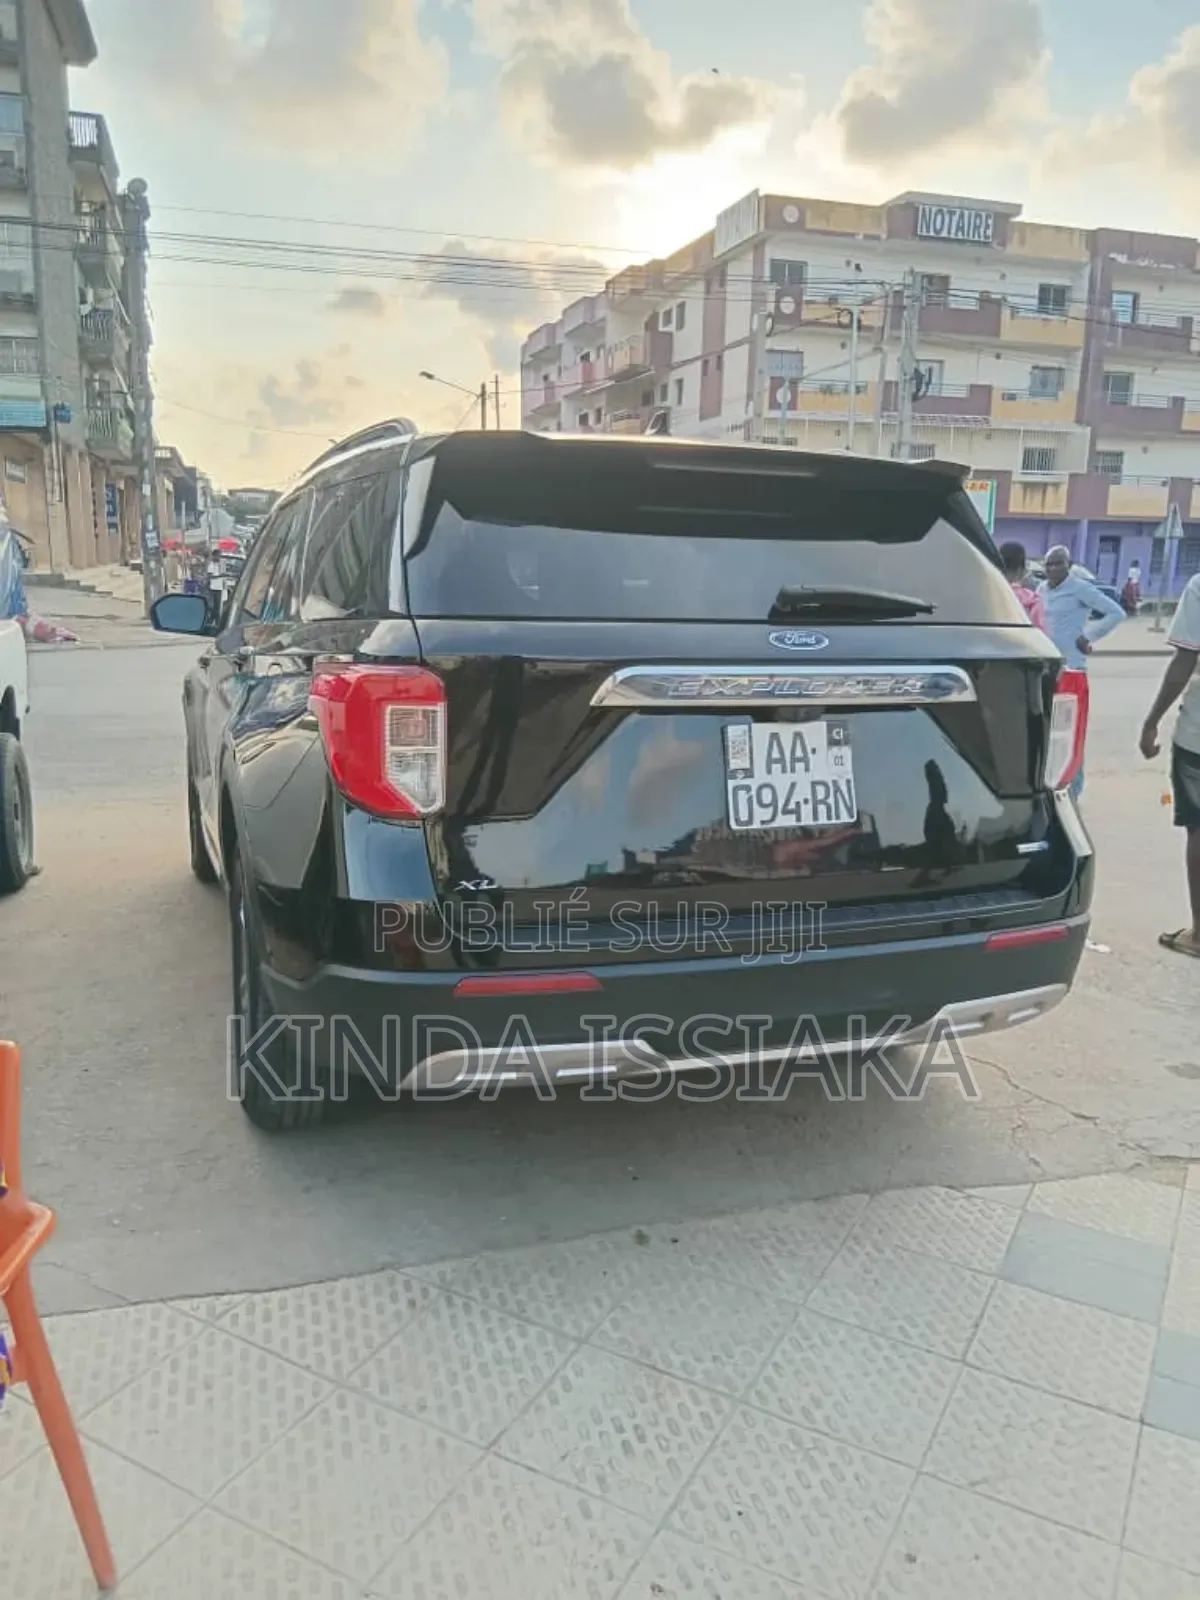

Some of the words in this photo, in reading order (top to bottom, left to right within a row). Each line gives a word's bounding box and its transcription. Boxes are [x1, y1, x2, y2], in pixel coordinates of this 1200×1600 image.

[920, 206, 993, 241] NOTAIRE
[783, 630, 816, 644] Ford
[667, 675, 925, 697] EXPLORER
